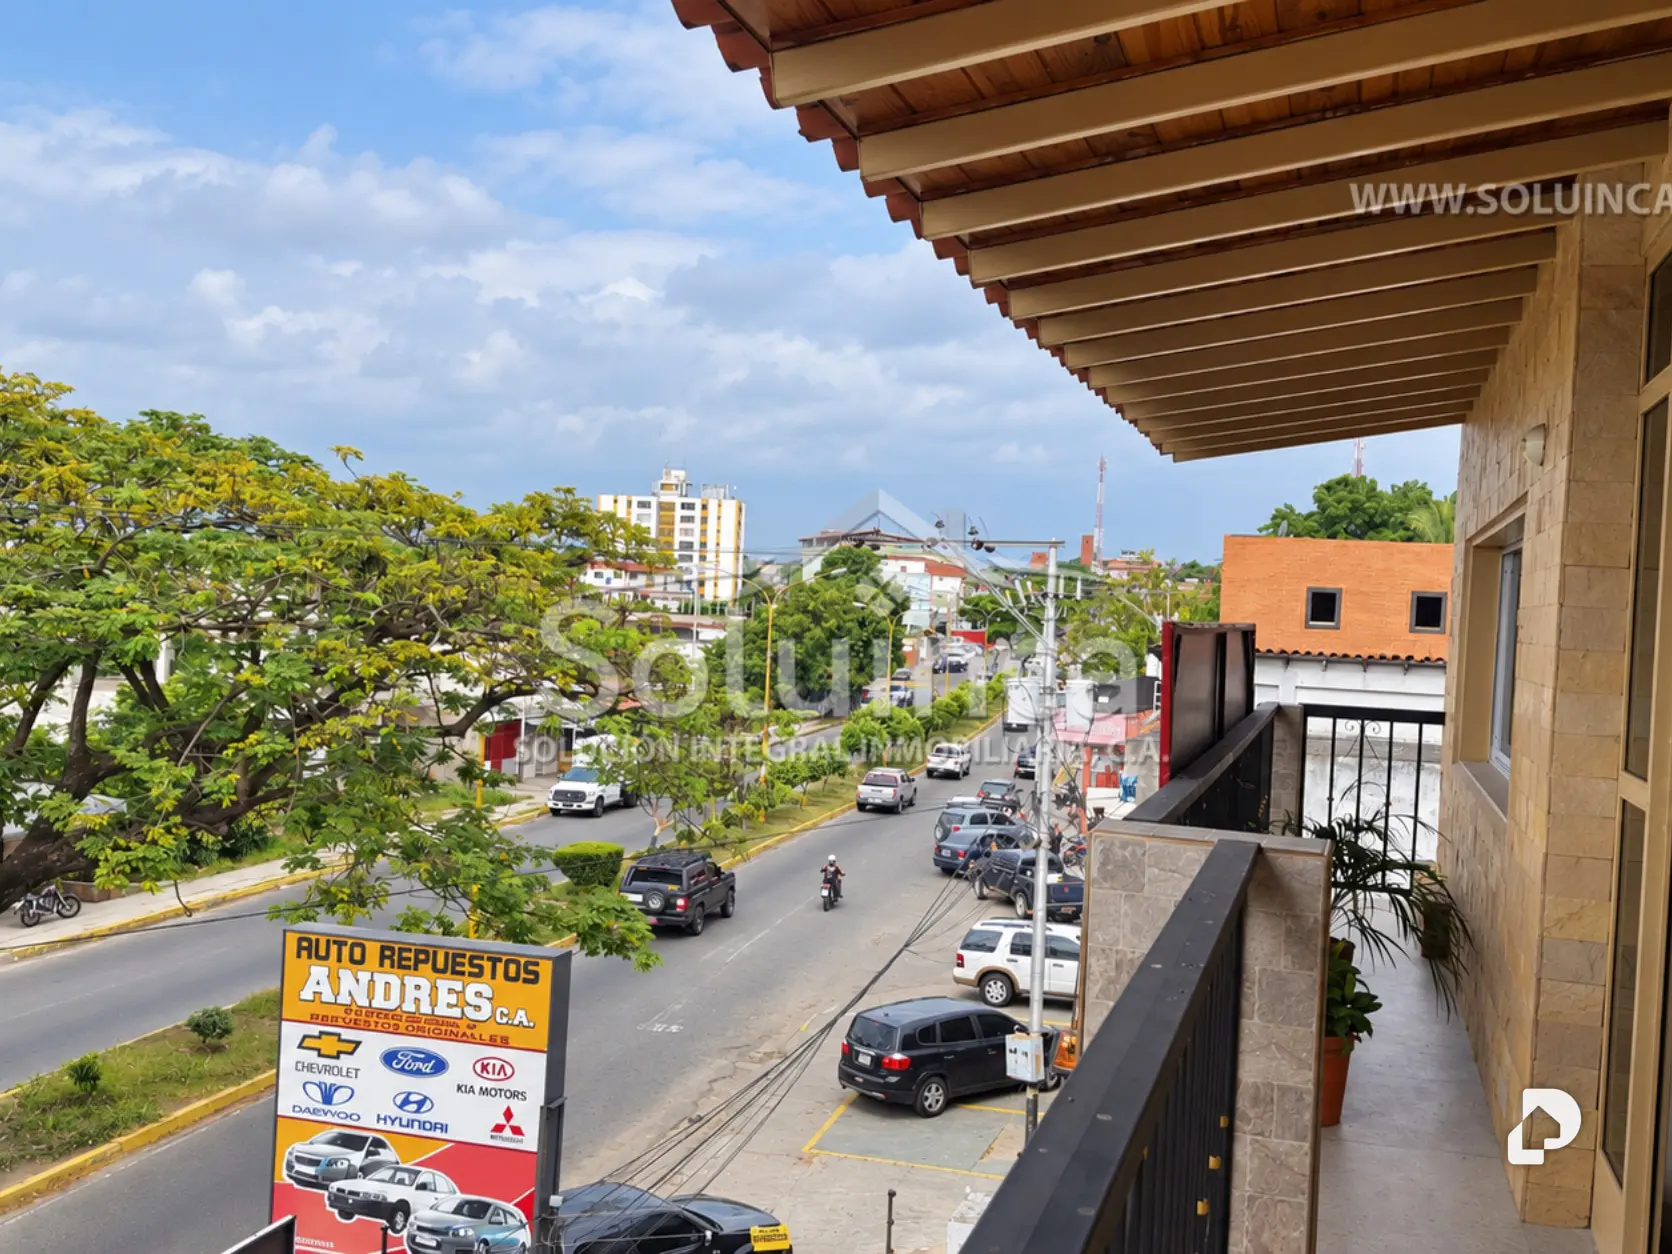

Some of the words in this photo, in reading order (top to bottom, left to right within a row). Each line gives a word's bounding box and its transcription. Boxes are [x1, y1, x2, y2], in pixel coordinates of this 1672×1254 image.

[296, 936, 366, 966] AUTO
[379, 944, 540, 985] REPUESTOS
[299, 965, 494, 1023] ANDRES
[495, 1006, 536, 1029] C.A.
[295, 1060, 361, 1080] CHEVROLET
[391, 1051, 435, 1074] Ford
[480, 1061, 508, 1078] KIA
[456, 1083, 476, 1097] KIA
[478, 1086, 528, 1102] MOTORS
[292, 1104, 361, 1122] DAEWOO
[376, 1113, 449, 1134] HYUNDAI
